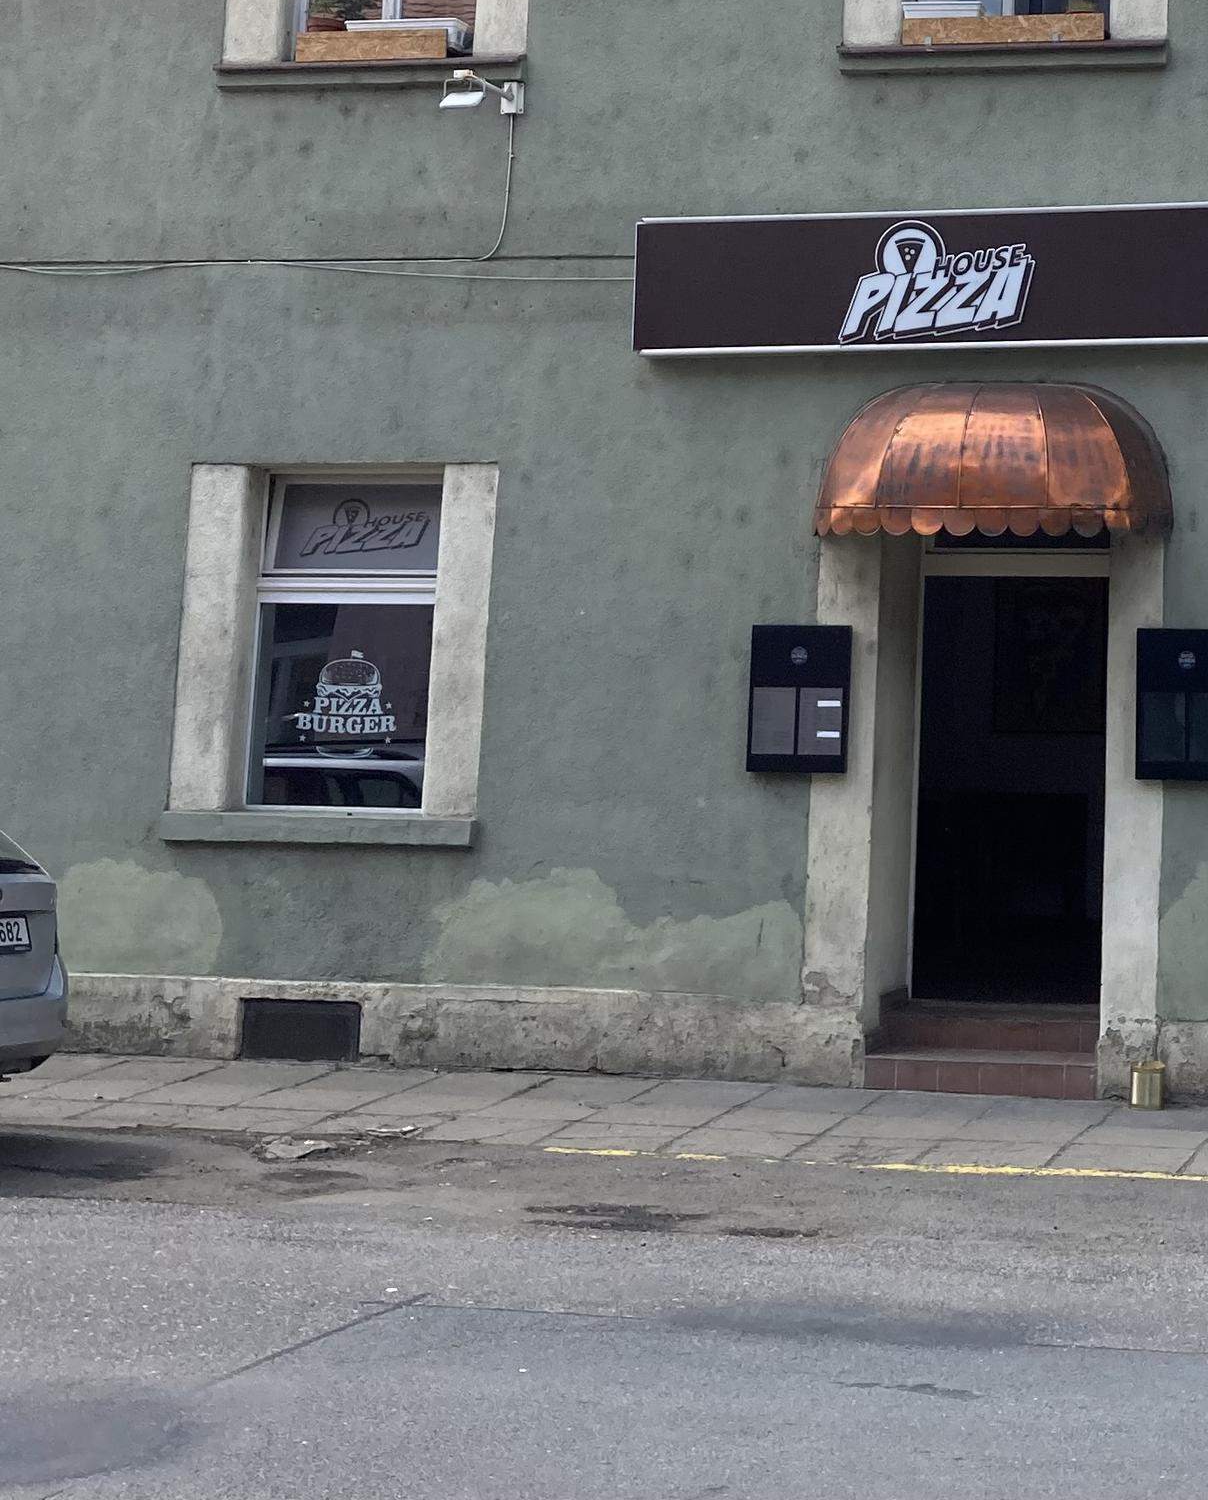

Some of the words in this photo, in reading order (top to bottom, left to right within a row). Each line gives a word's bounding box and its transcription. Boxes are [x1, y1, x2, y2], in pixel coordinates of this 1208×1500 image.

[931, 244, 1026, 279] HOUSE
[839, 257, 1034, 343] PIZZA
[364, 511, 426, 528] HOUSE
[300, 518, 431, 557] PIZZA
[312, 696, 384, 716] PIZZA
[296, 712, 397, 734] BURGER
[0, 921, 22, 942] 682
